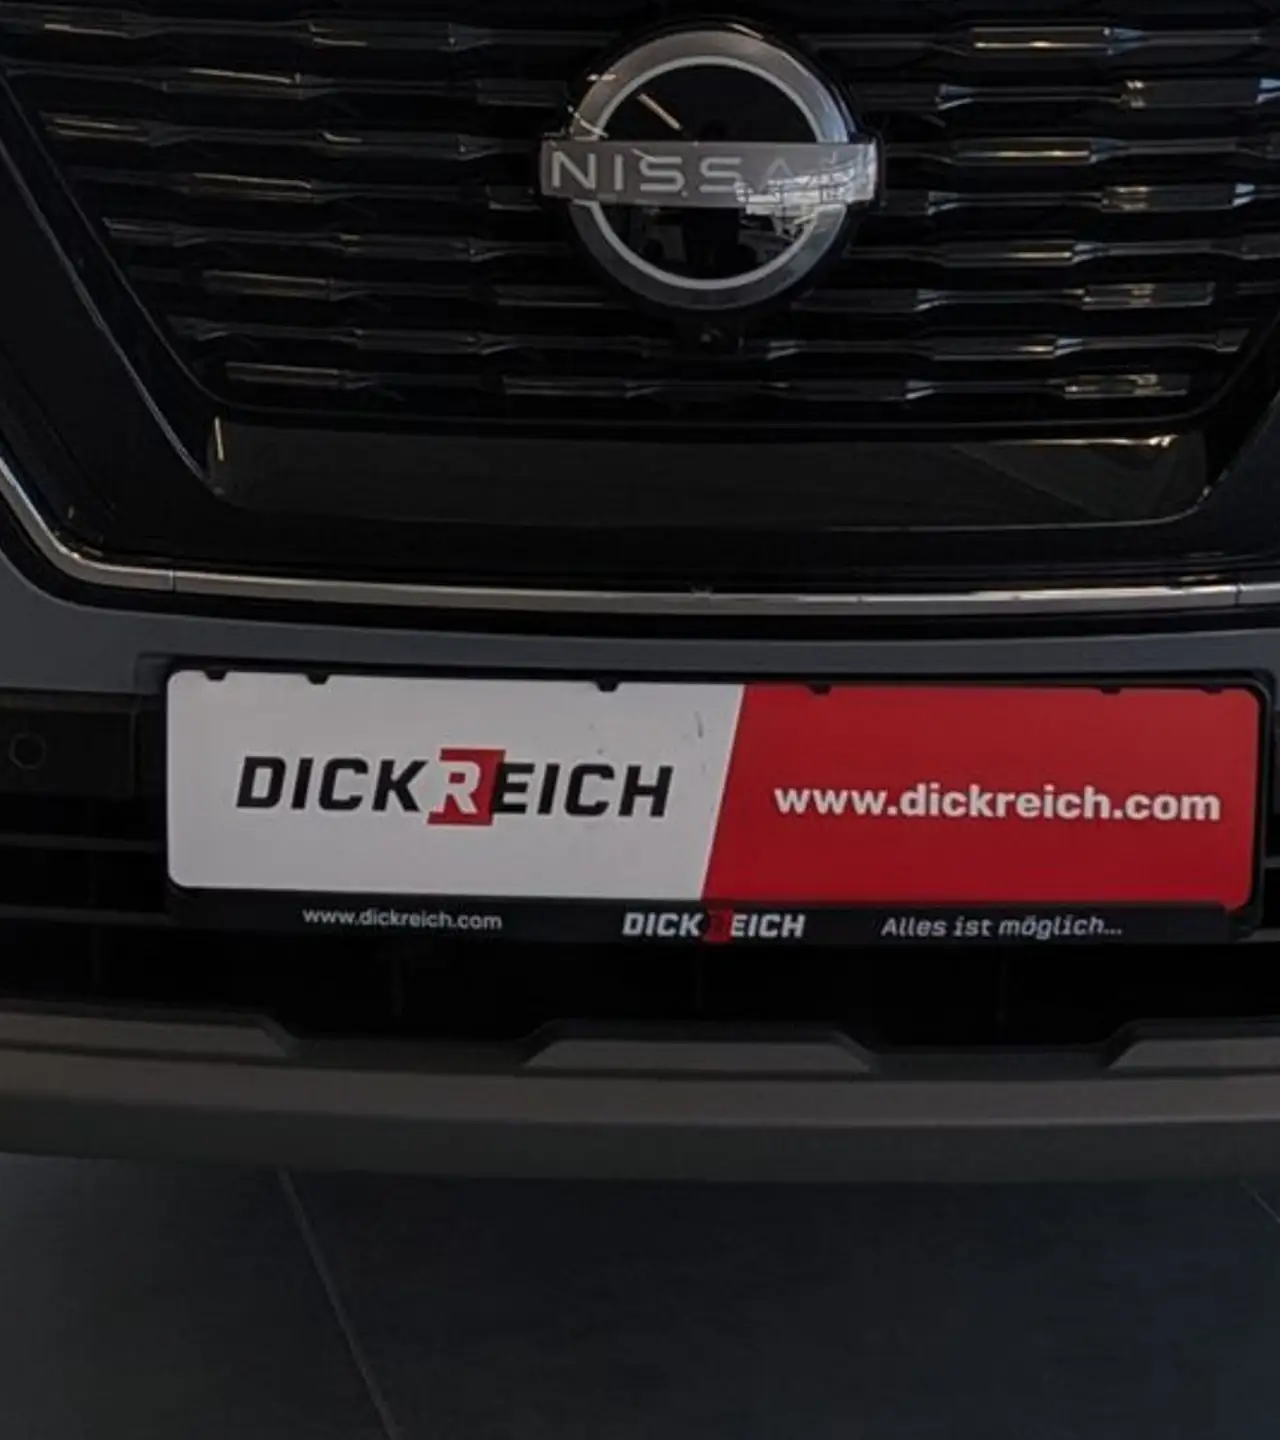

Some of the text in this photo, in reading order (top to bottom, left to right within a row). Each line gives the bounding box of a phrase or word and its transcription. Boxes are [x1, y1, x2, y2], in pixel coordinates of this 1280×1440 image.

[551, 150, 866, 194] NISSA
[235, 752, 674, 820] DICKREICH
[774, 782, 1220, 822] www.dickreich.com
[302, 908, 502, 931] www.dickreich.com
[621, 910, 806, 939] DICKEICH
[880, 914, 1123, 941] Alles ist möglich...
